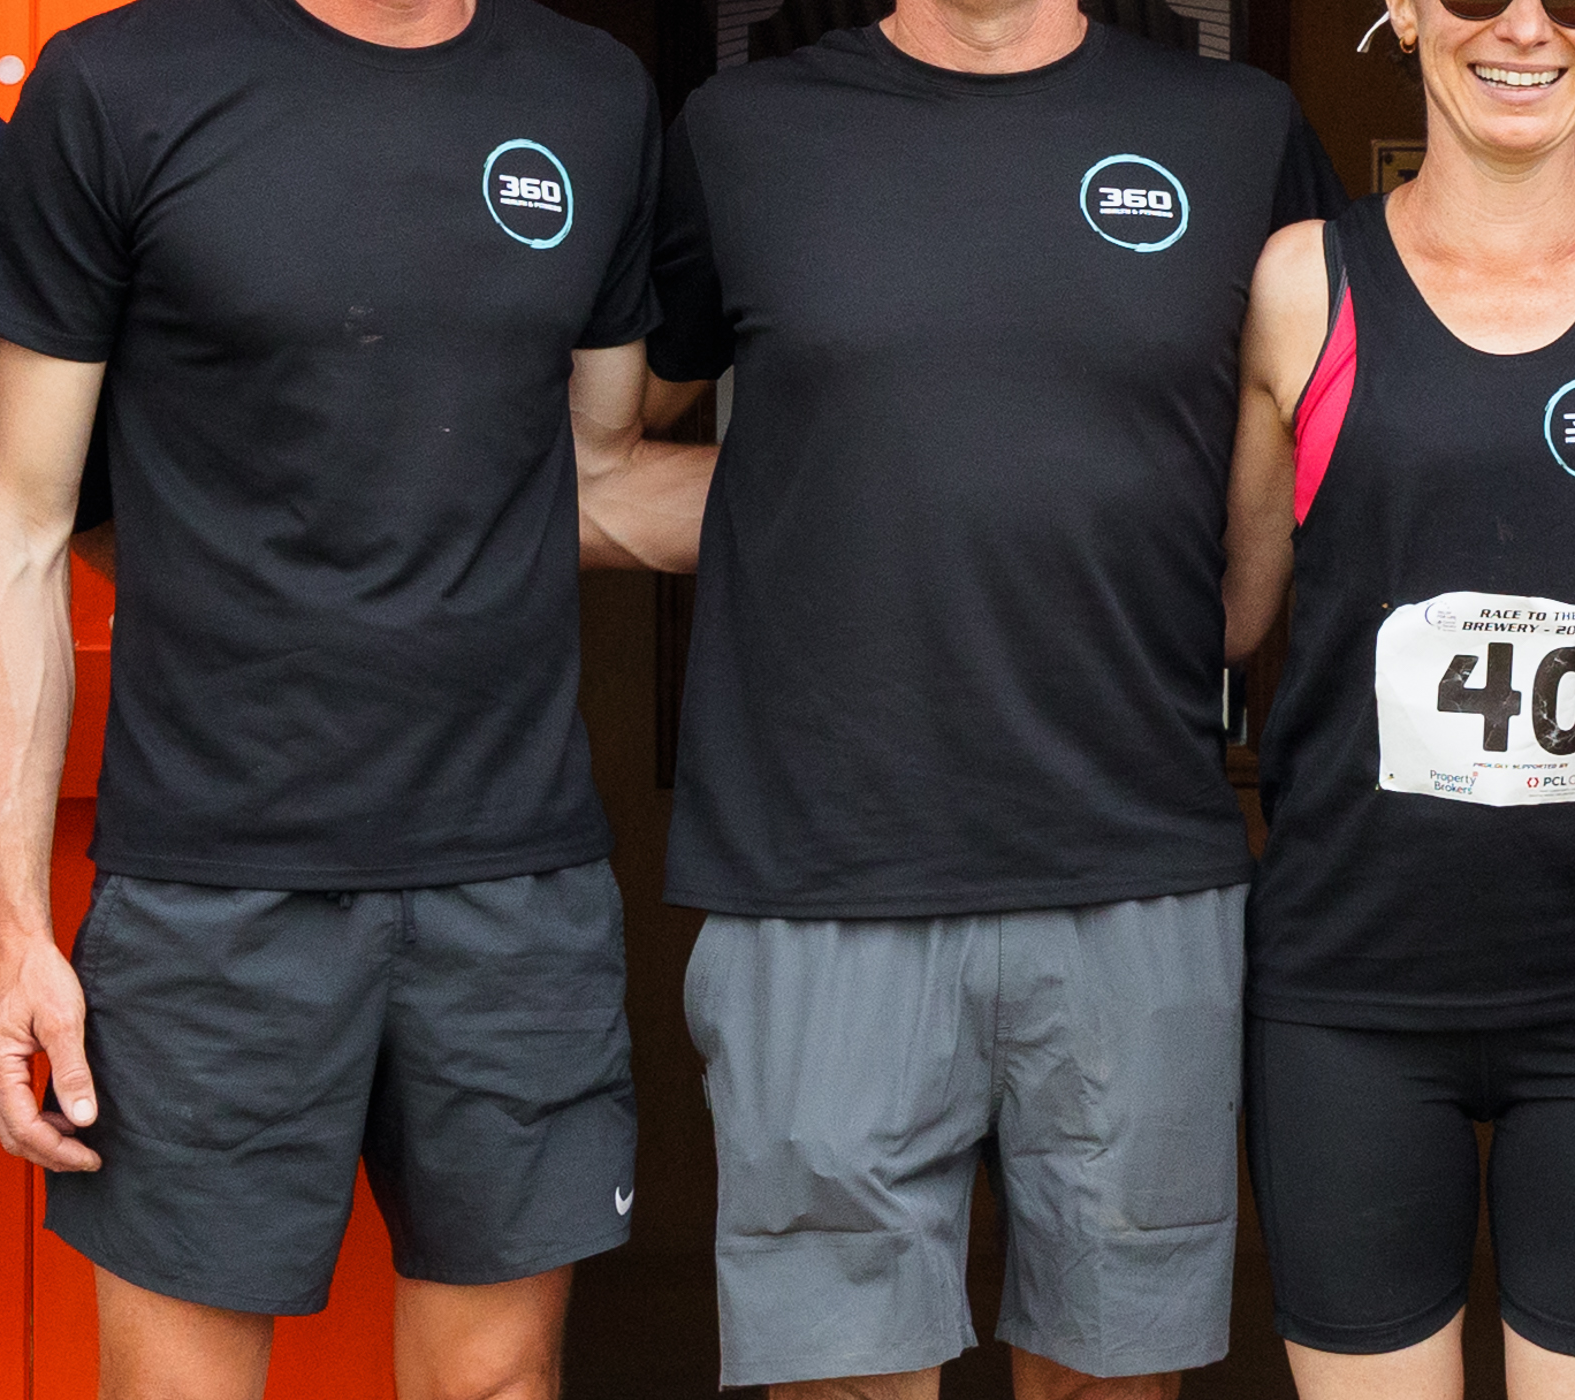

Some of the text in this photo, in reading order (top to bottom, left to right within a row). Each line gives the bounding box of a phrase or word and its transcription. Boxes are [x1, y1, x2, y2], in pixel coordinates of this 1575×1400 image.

[499, 174, 561, 203] 360
[1099, 187, 1172, 210] 360
[1480, 608, 1522, 620] RACE
[1527, 610, 1547, 621] TO
[1462, 621, 1538, 633] BREWERY
[1430, 769, 1476, 788] Property
[1543, 776, 1567, 787] PCL
[1434, 781, 1473, 795] Brokers
